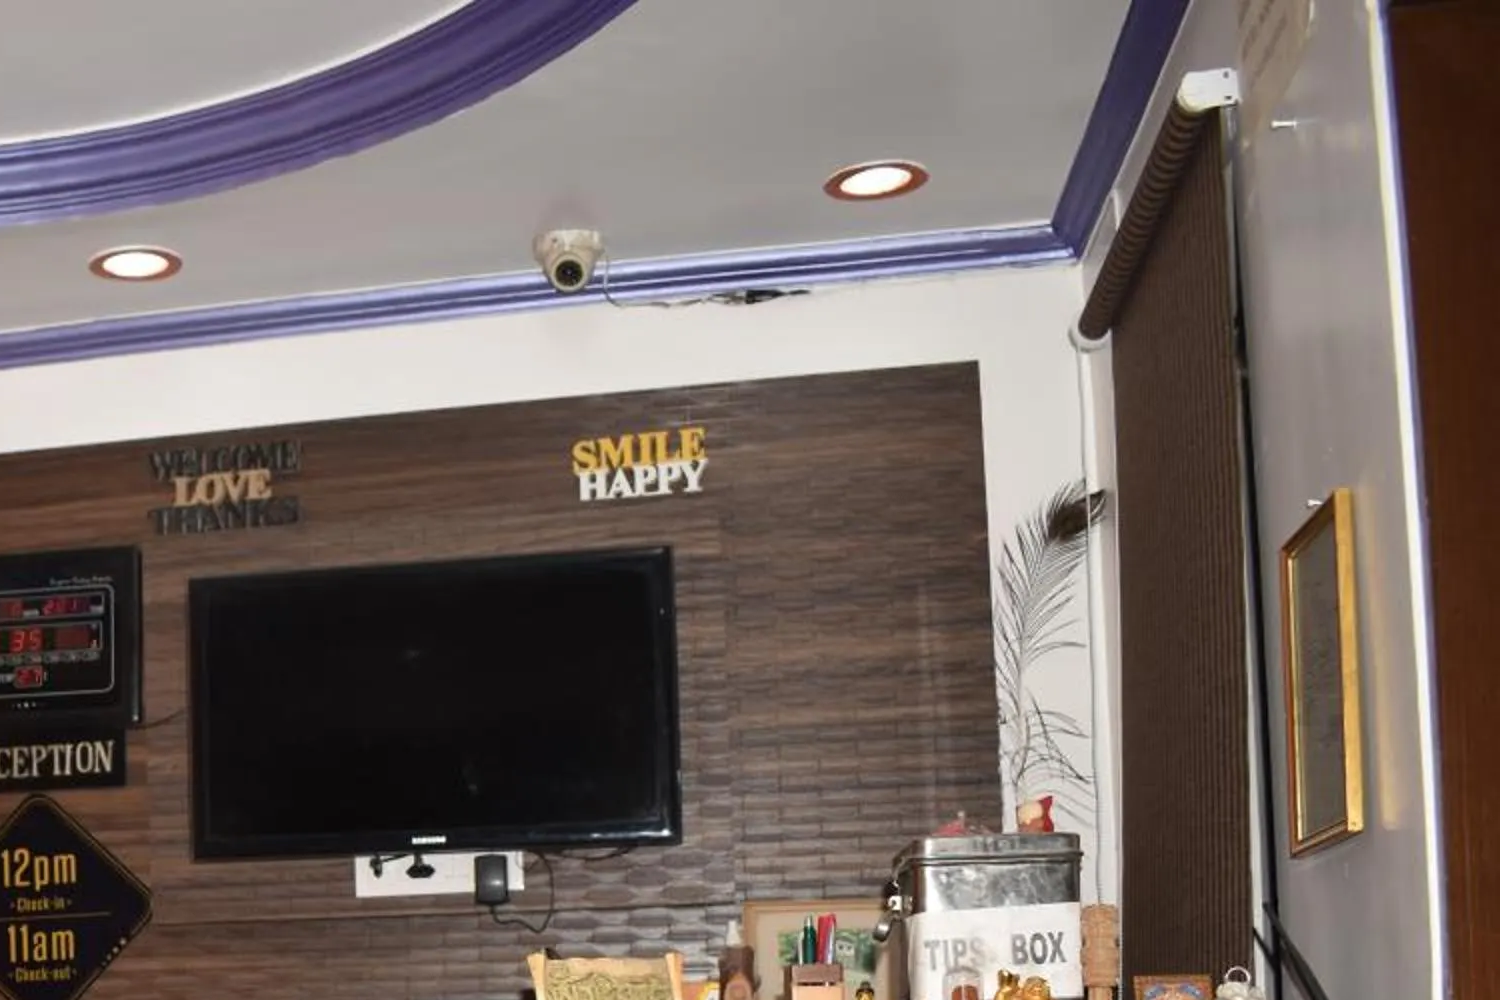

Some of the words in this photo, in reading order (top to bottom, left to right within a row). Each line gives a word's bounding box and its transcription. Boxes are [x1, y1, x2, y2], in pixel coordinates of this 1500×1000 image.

[149, 440, 303, 482] WELCOME
[572, 427, 707, 476] SMILE
[170, 468, 272, 507] LOVE
[579, 458, 708, 501] HAPPY
[148, 497, 302, 536] THANKS
[1, 848, 77, 891] 12pm
[7, 924, 75, 963] 11am
[924, 935, 987, 973] TIPS
[1011, 931, 1067, 966] BOX
